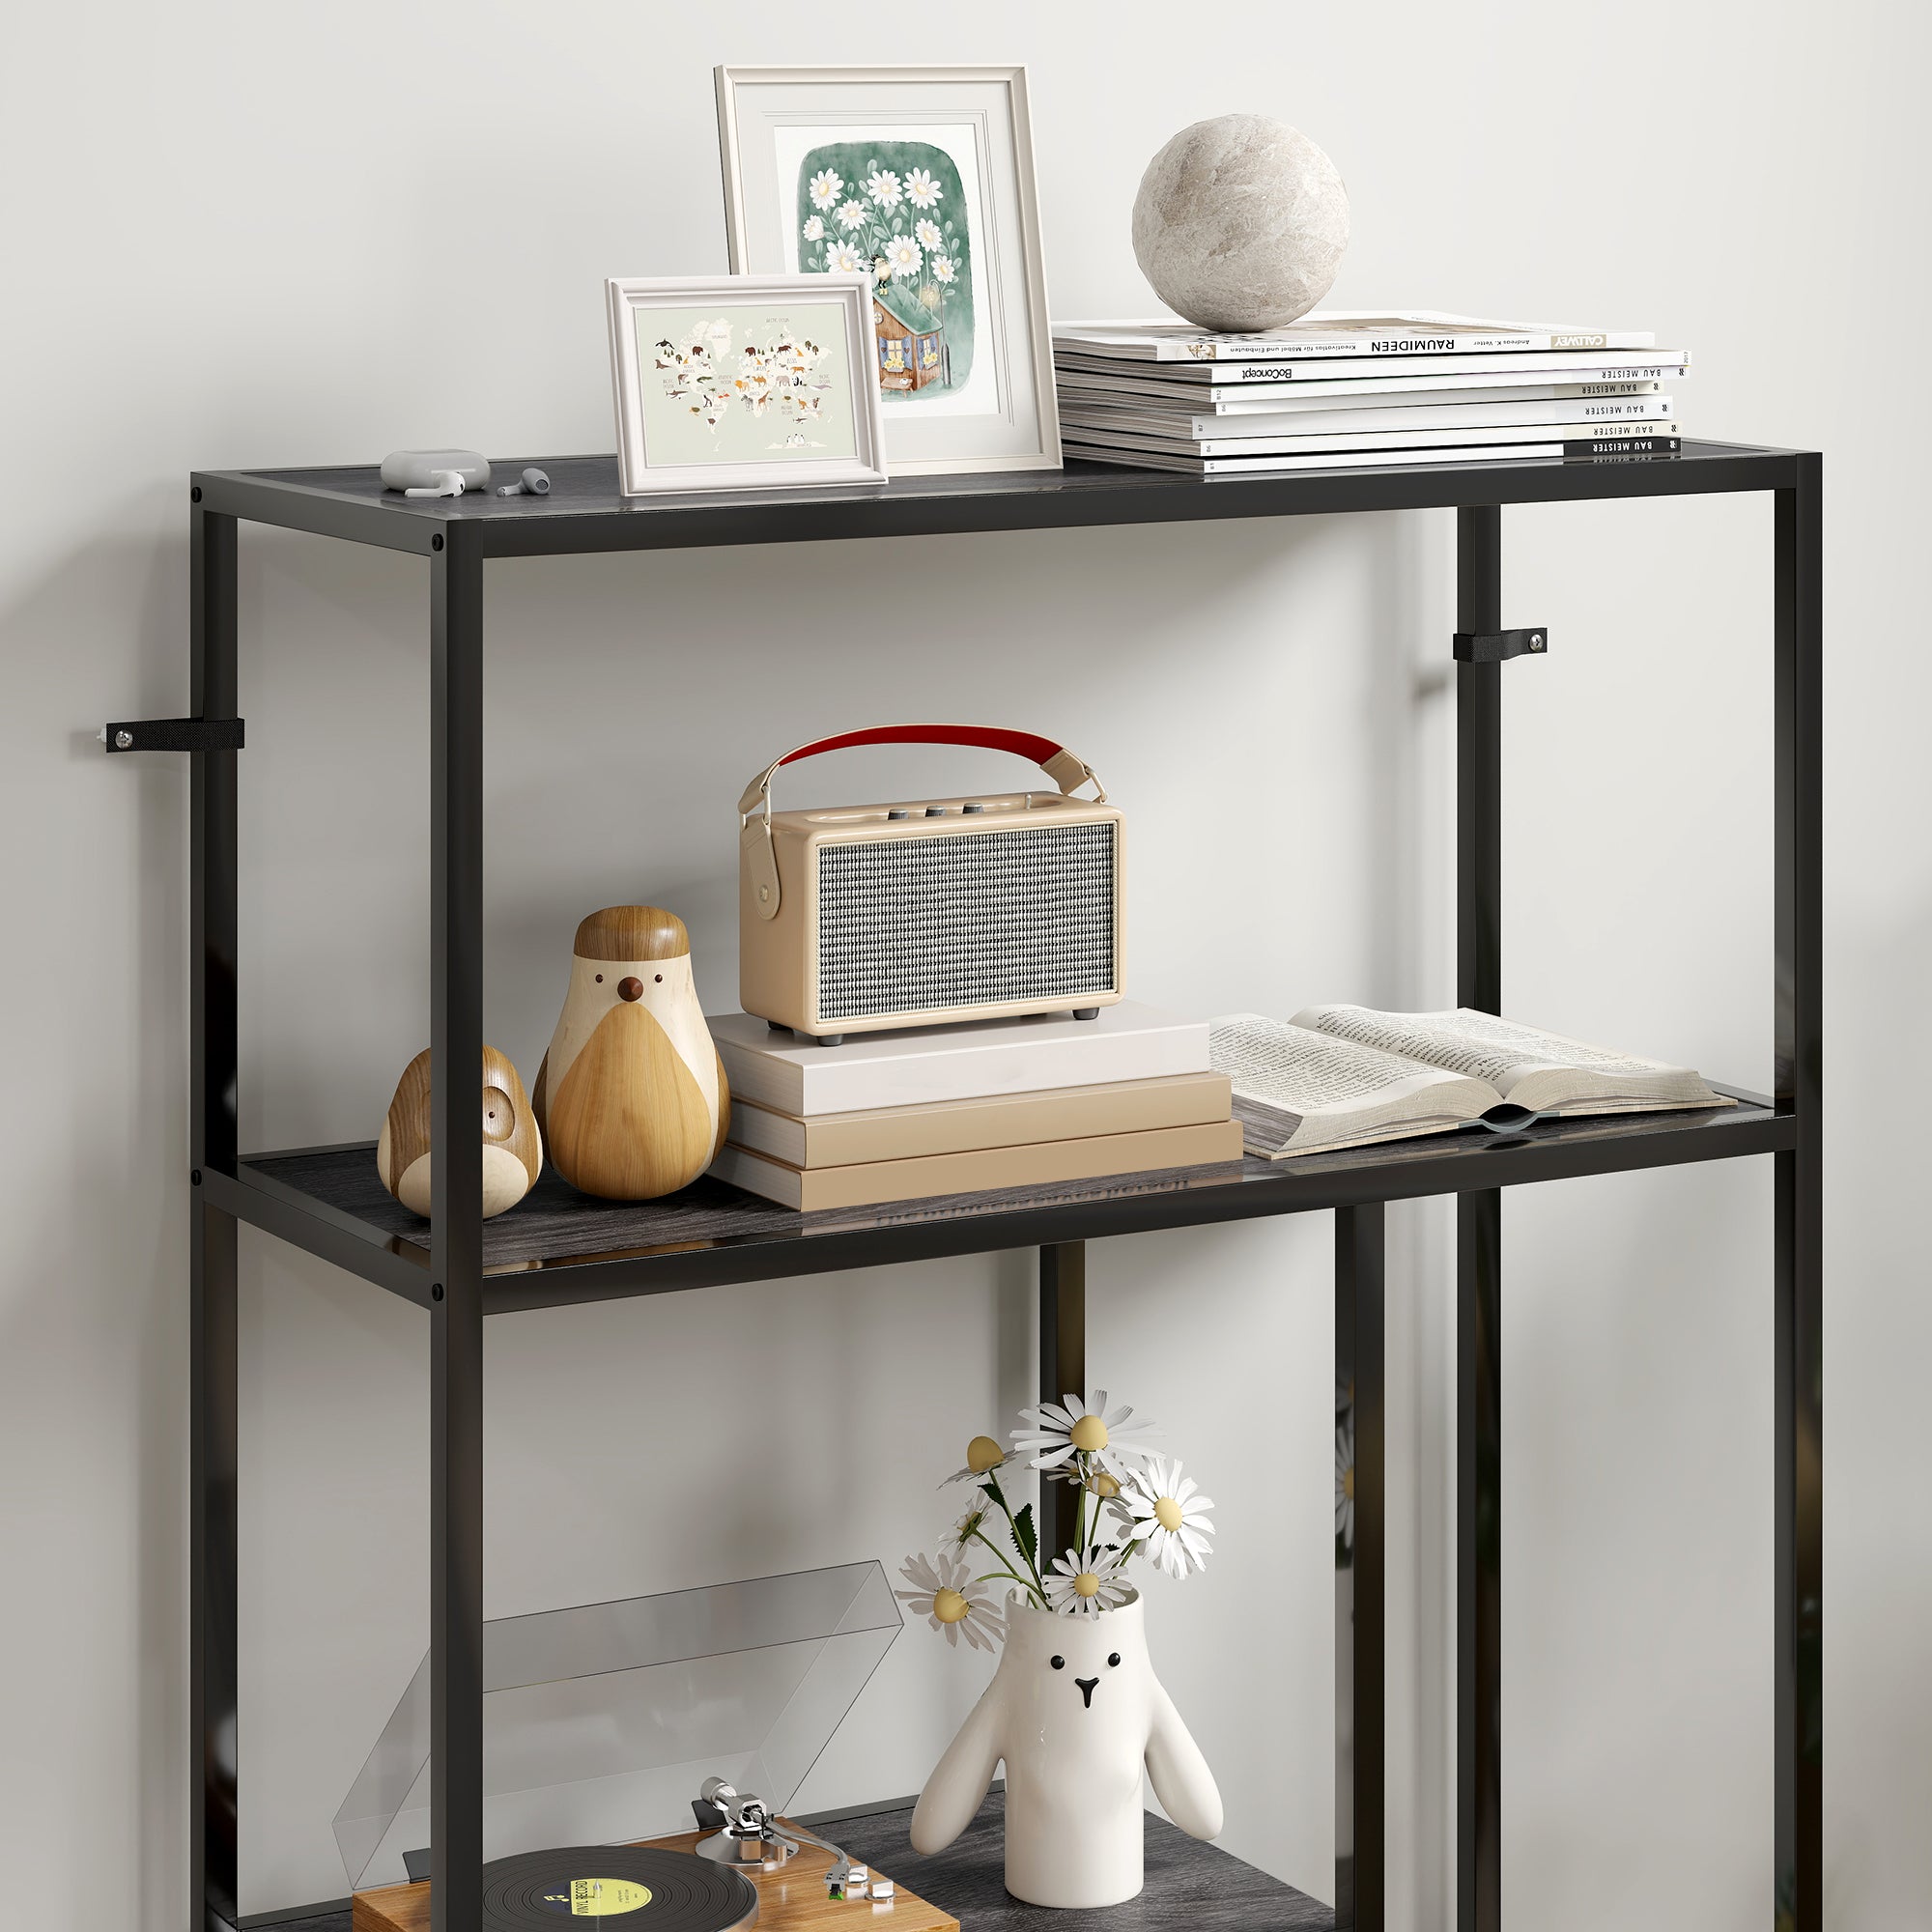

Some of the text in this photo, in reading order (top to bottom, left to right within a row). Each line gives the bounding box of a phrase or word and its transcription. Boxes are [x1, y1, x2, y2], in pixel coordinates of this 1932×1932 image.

[1371, 339, 1455, 352] RAUMIDEEN
[1554, 335, 1604, 347] CALLWEY
[1241, 367, 1293, 380] BoConcept
[1601, 368, 1662, 379] BAU MEISTER
[1581, 384, 1637, 394] BAU MEISTER
[1584, 405, 1644, 415] BAU MEISTER
[1593, 425, 1654, 436] BAU MEISTER
[1592, 441, 1653, 452] BAU MEISTER
[576, 1881, 588, 1914] VINYL RECORD
